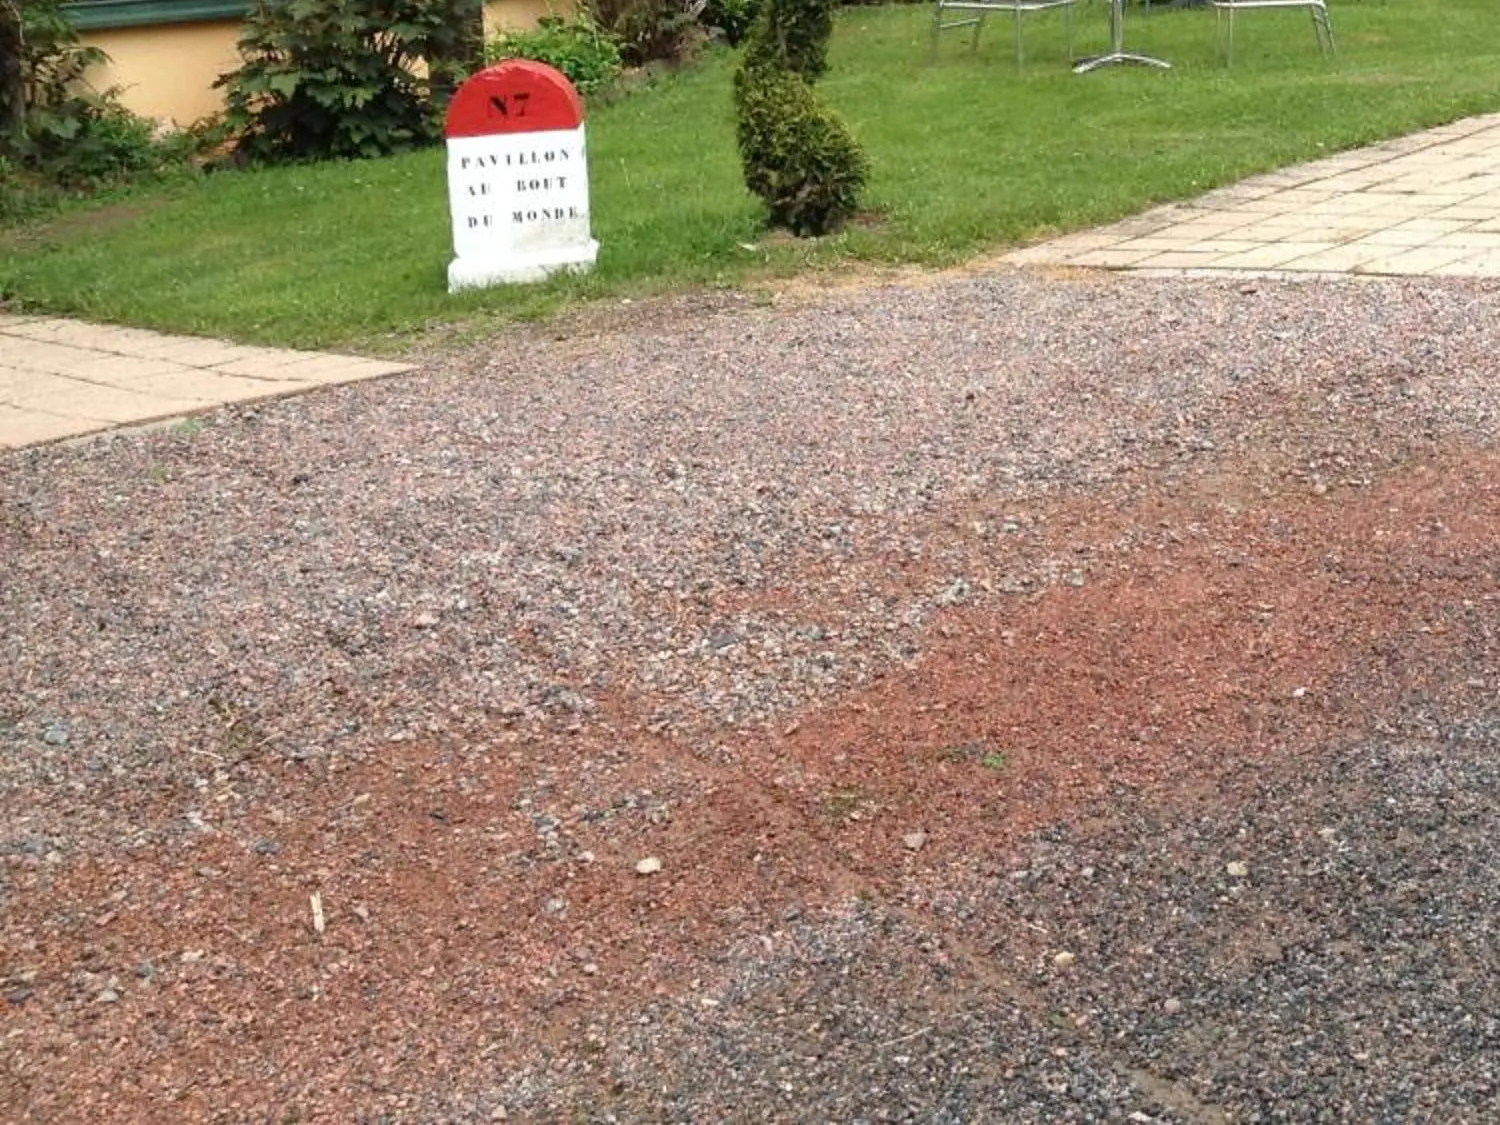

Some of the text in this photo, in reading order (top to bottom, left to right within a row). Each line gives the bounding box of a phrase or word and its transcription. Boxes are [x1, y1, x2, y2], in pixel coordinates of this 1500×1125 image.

[488, 92, 531, 119] N7
[461, 148, 570, 169] PAVILLON
[467, 176, 568, 197] AU BOUT
[467, 206, 578, 229] DU MONDE
